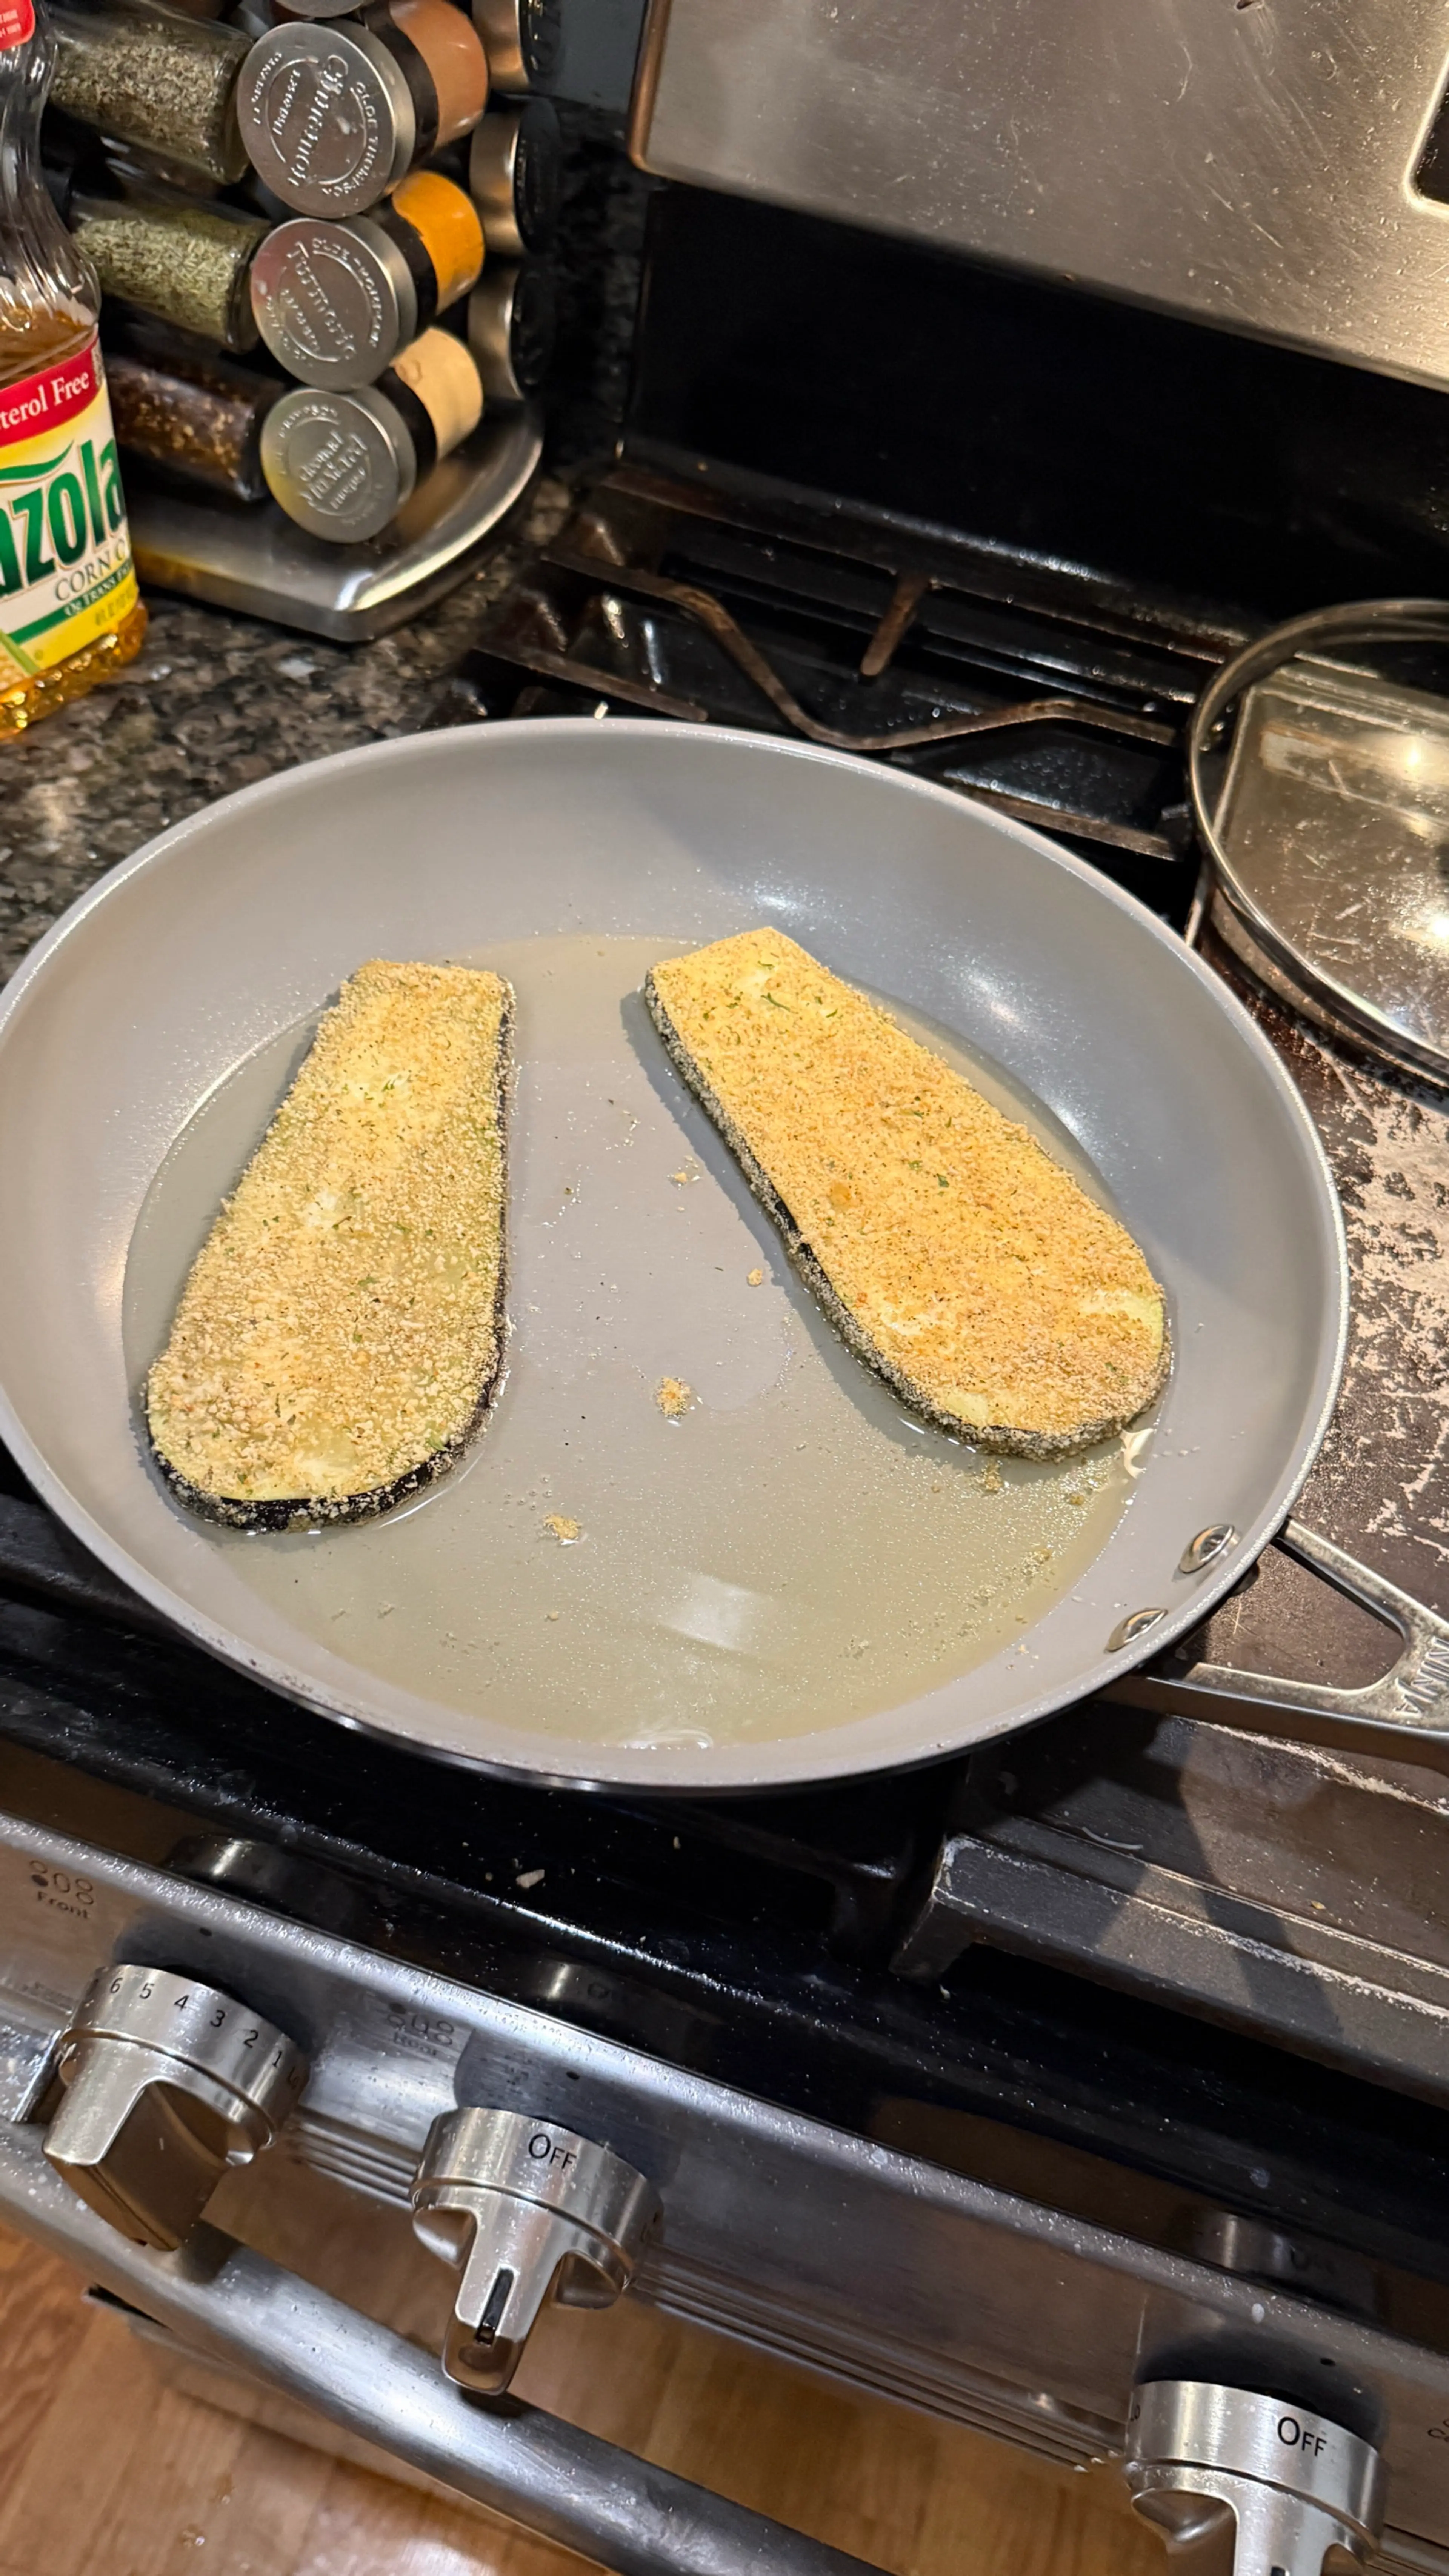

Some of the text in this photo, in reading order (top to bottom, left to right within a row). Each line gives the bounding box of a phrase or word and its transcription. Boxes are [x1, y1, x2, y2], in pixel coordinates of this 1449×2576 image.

[287, 54, 349, 187] Cinnamon
[286, 241, 357, 360] Turmeric
[0, 371, 90, 430] terol Free
[55, 549, 111, 601] CORN
[38, 1890, 88, 1919] Front
[110, 1977, 123, 1994] 6
[139, 1983, 155, 1999] 5
[174, 1994, 189, 2011] 4
[210, 2009, 226, 2028] 3
[243, 2029, 259, 2049] 2
[272, 2050, 283, 2068] 1
[528, 2133, 577, 2170] OFF
[1277, 2416, 1327, 2457] OFF
